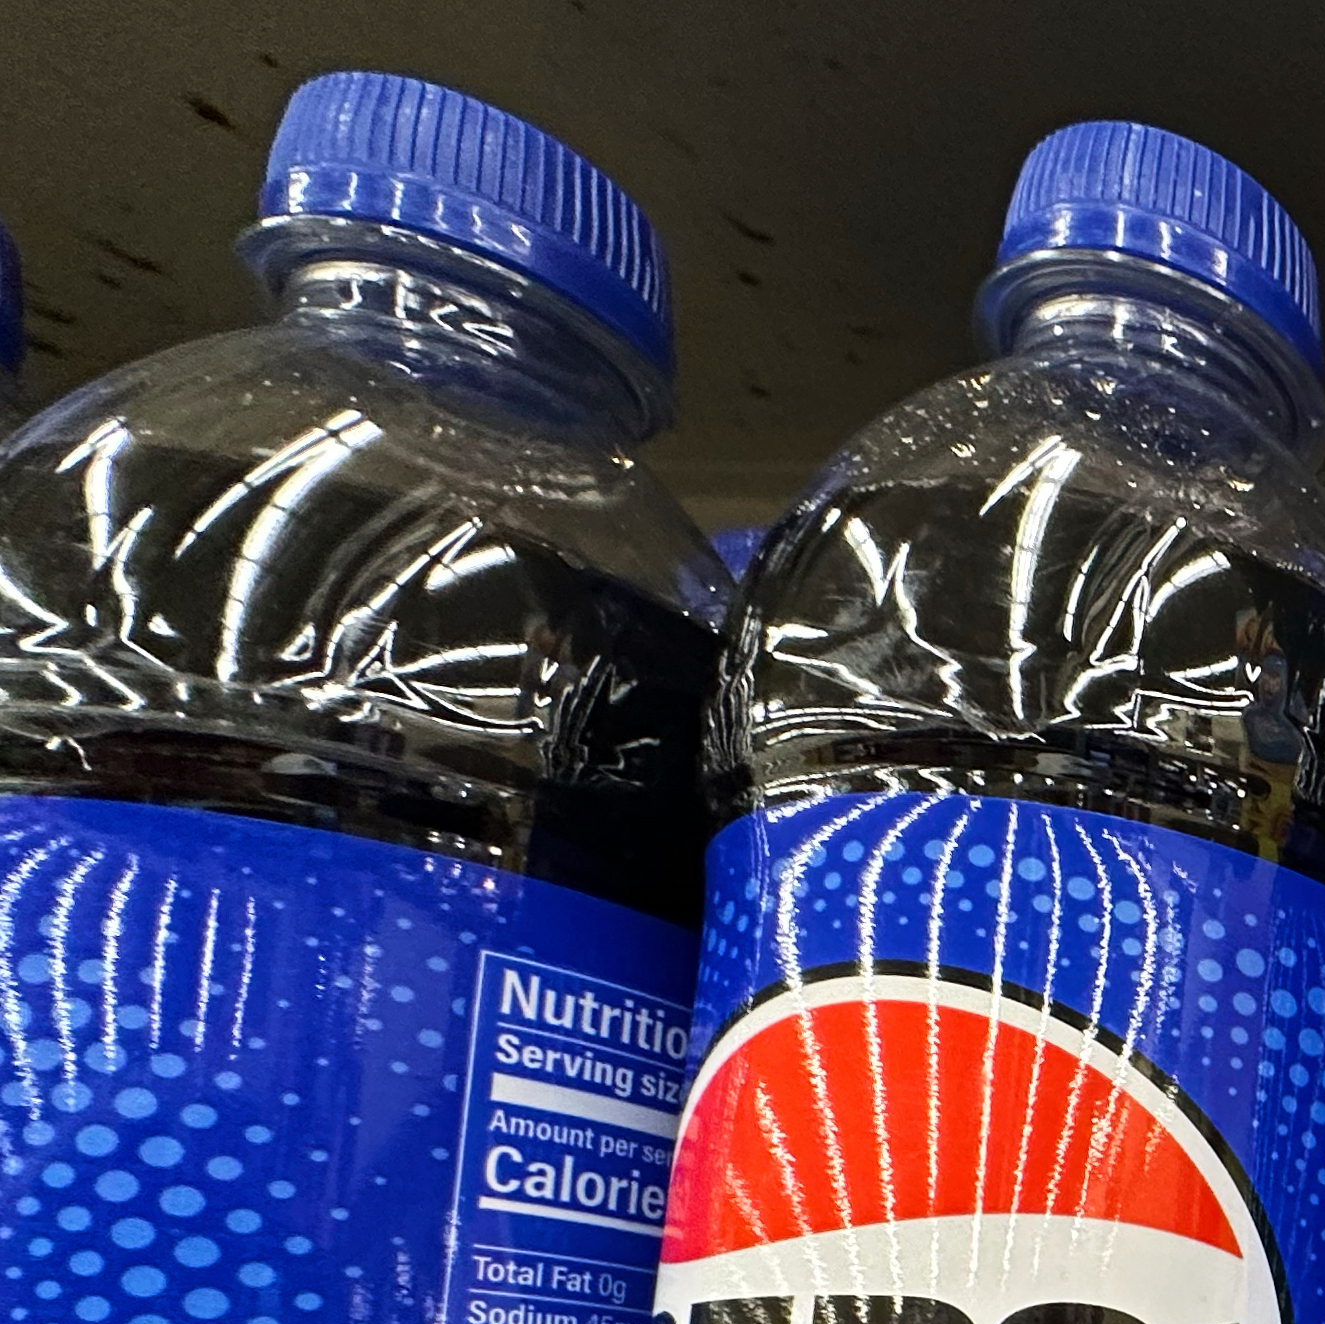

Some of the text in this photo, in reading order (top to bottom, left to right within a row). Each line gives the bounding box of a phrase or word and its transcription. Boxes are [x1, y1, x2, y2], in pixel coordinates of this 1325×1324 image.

[496, 1033, 634, 1098] Serving
[489, 1110, 595, 1150] Amount
[601, 1134, 638, 1160] per
[483, 1145, 665, 1222] Calorie
[473, 1254, 627, 1303] Total Fat 0g
